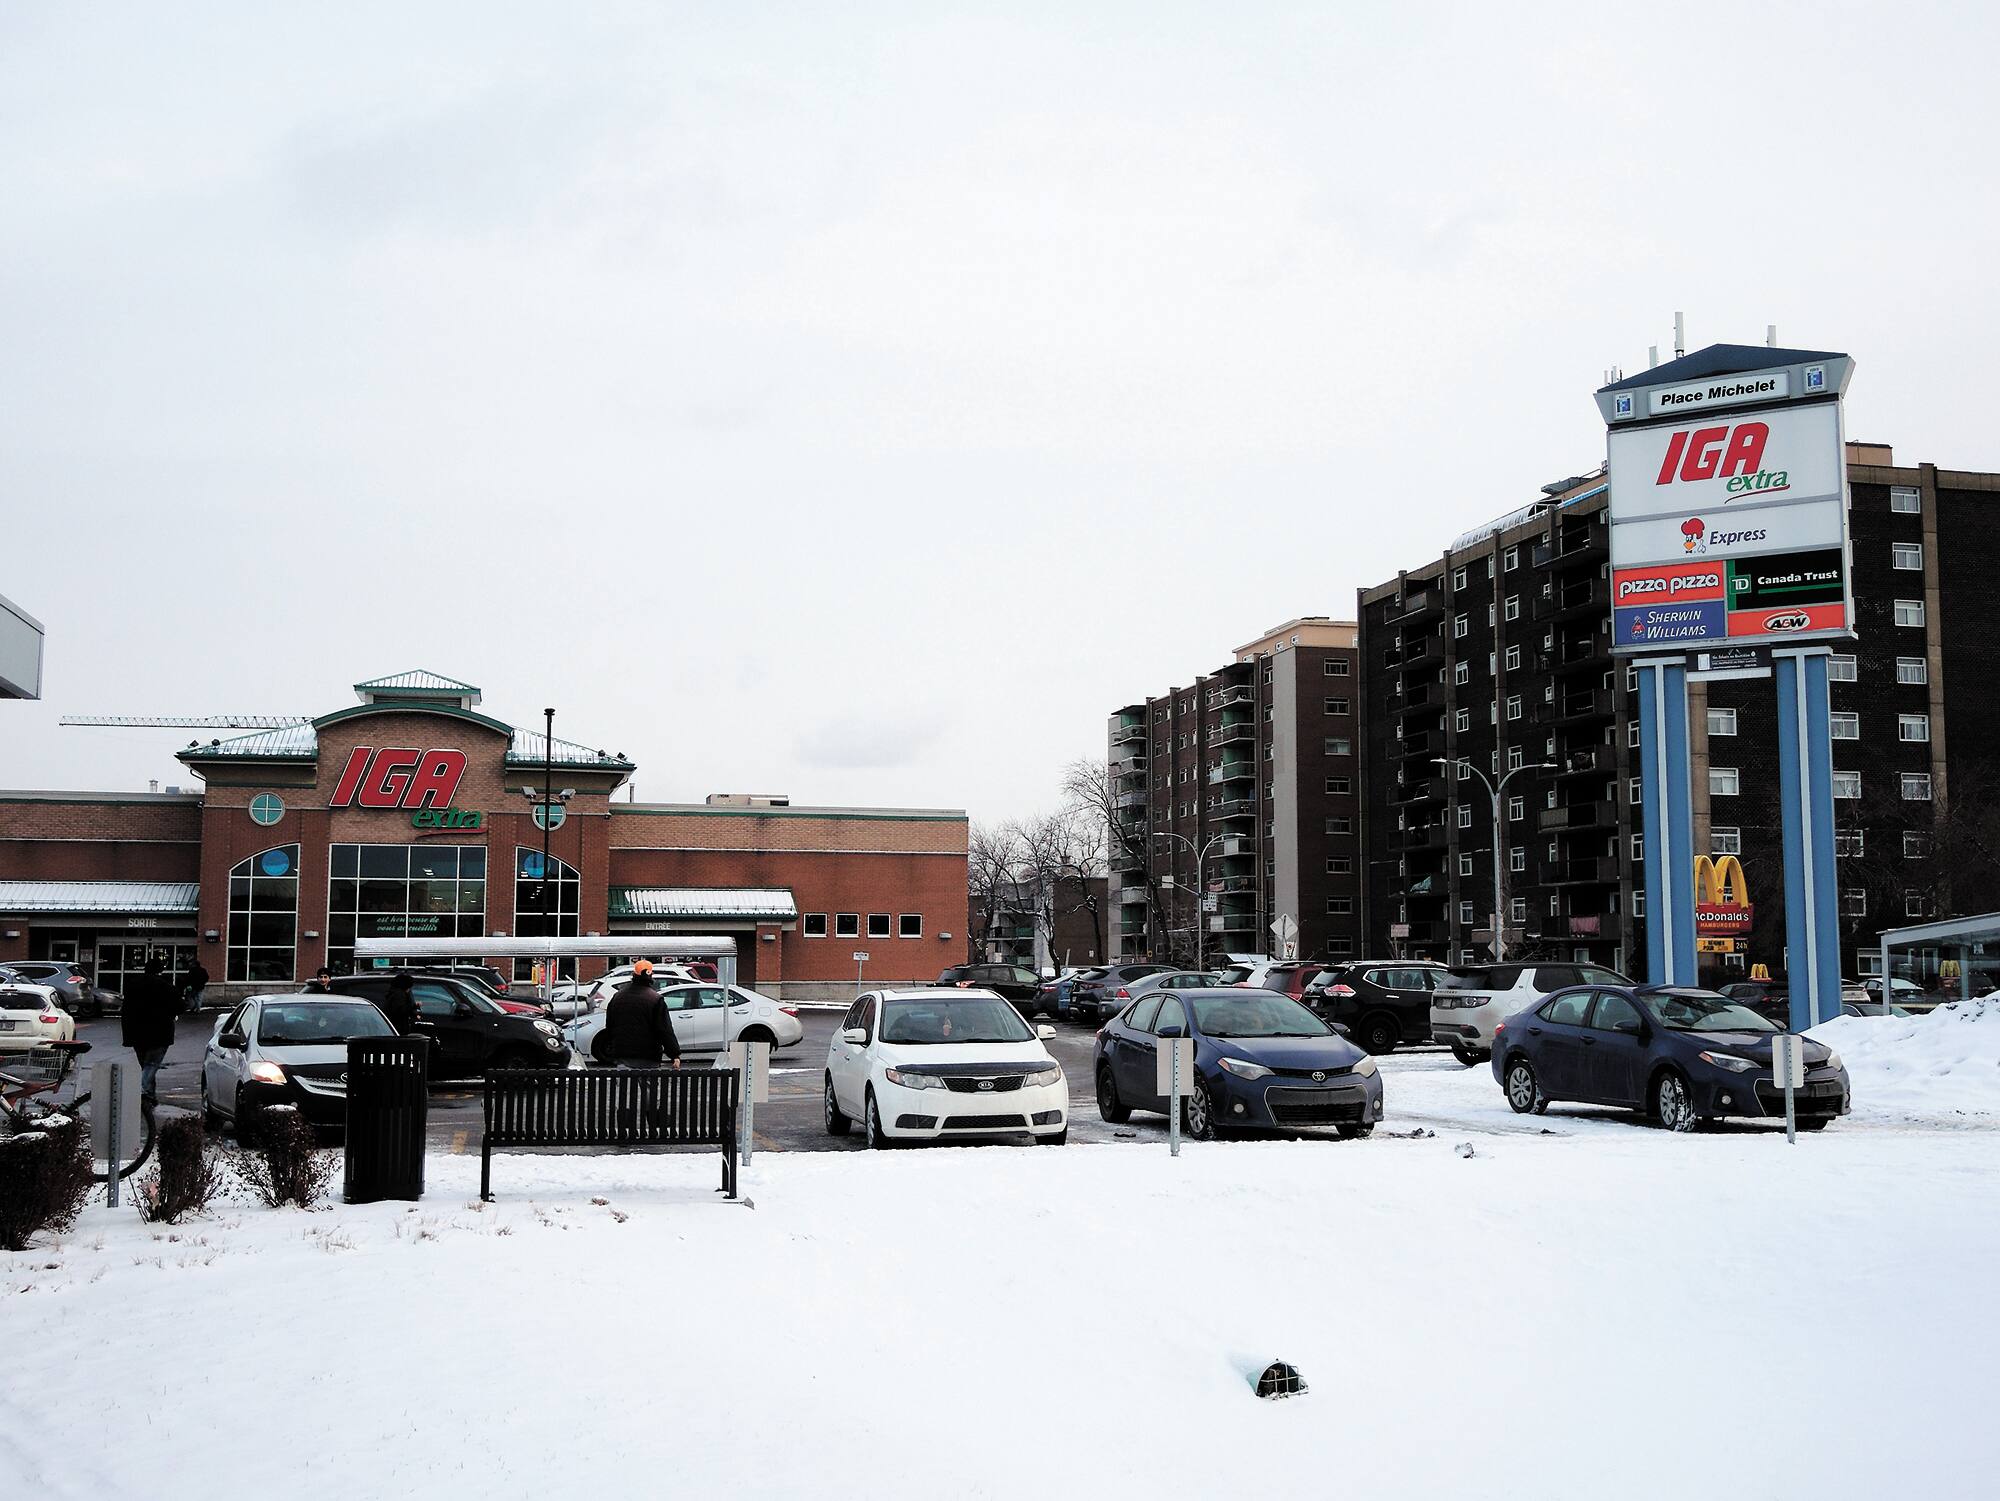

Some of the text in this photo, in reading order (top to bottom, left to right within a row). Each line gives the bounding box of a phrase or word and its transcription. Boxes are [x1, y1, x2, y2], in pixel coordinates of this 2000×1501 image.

[1661, 378, 1776, 406] Place Michelet
[1655, 421, 1770, 486] IGA
[1726, 469, 1788, 493] extra
[1709, 529, 1767, 546] Express
[1619, 573, 1719, 599] pizza pizza
[1731, 569, 1838, 590] TD Canada Trust
[1647, 610, 1702, 624] SHERWIN
[1770, 616, 1807, 629] A&W
[1647, 625, 1707, 639] WILLIAMS
[328, 745, 468, 810] IGA
[411, 806, 482, 829] extra
[128, 918, 157, 928] SORTIE
